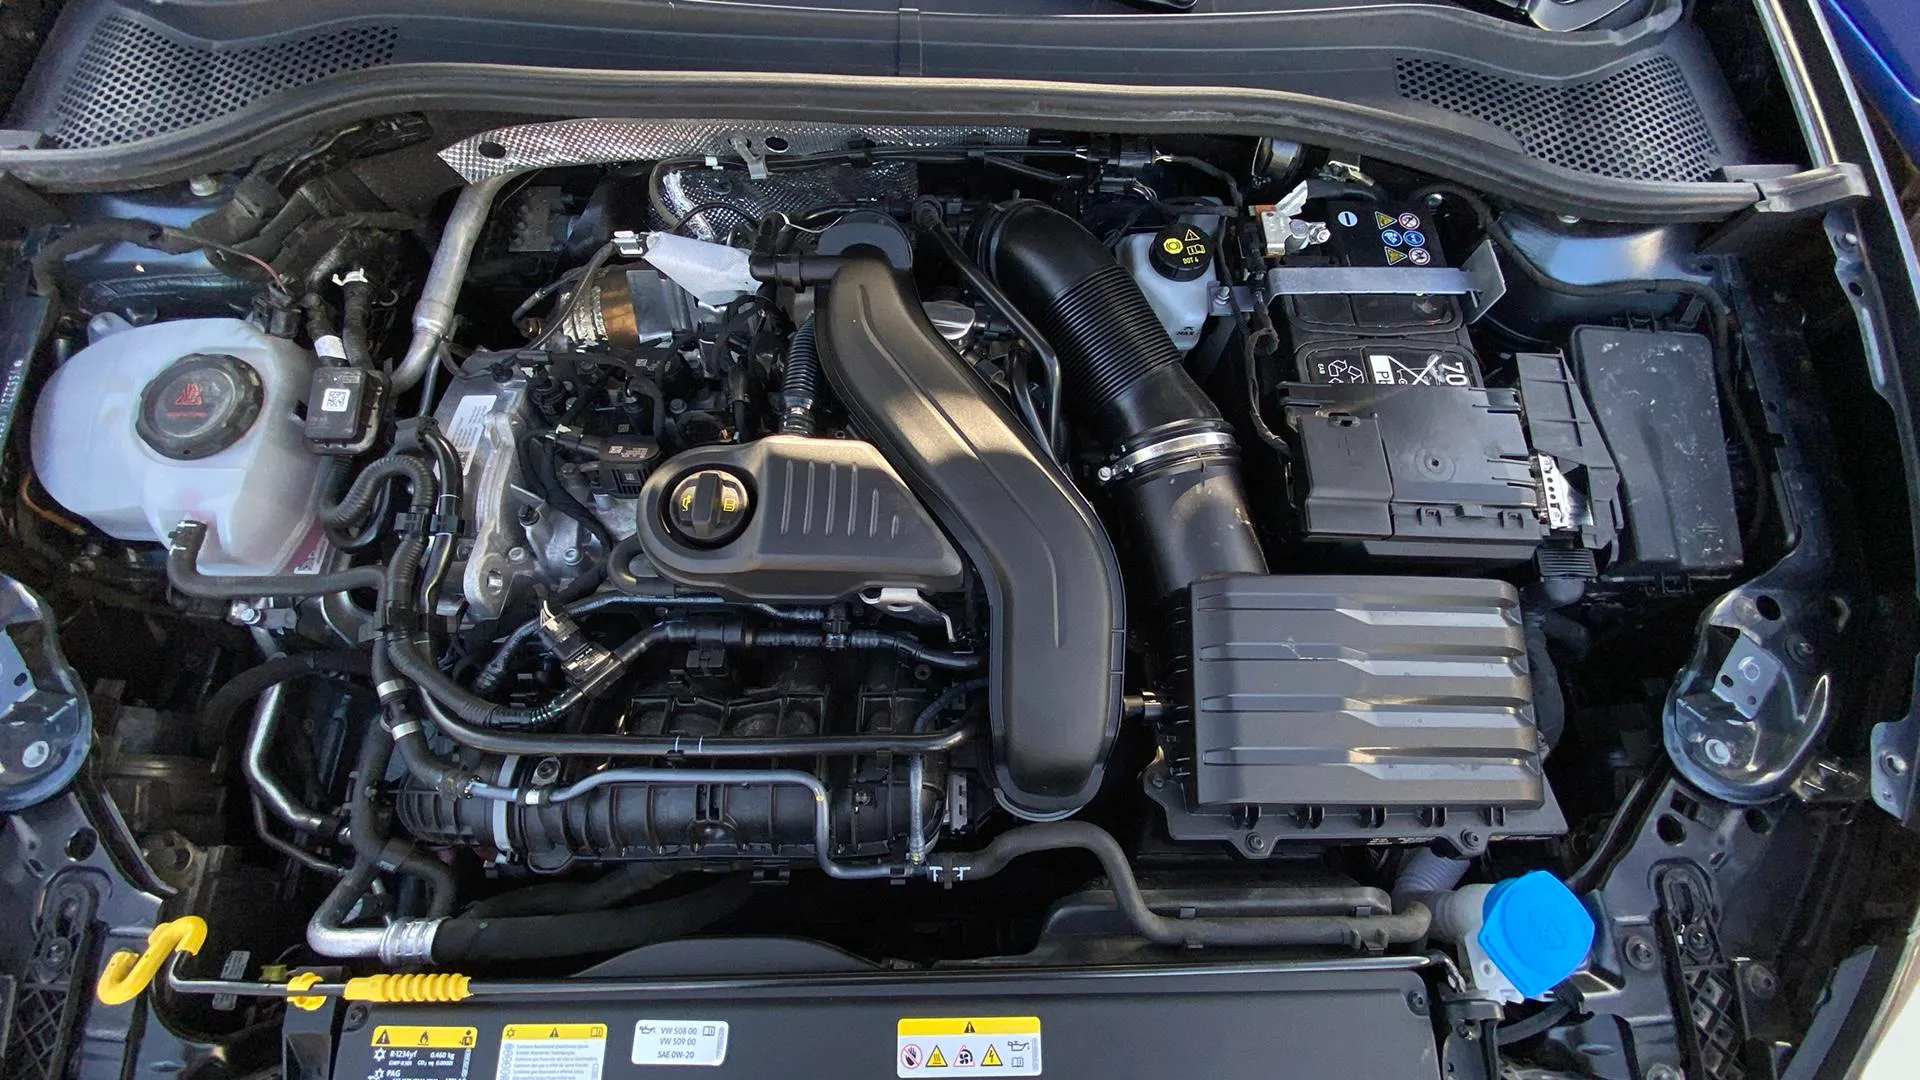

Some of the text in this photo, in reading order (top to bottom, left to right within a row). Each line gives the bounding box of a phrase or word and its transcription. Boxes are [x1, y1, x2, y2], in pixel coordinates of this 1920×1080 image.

[1182, 256, 1194, 264] DOT
[1441, 361, 1468, 386] 70
[660, 1027, 698, 1035] VW 508 00
[659, 1038, 697, 1046] VW 509 00
[657, 1051, 695, 1059] SAE 0W-20
[386, 1069, 401, 1078] PAG
